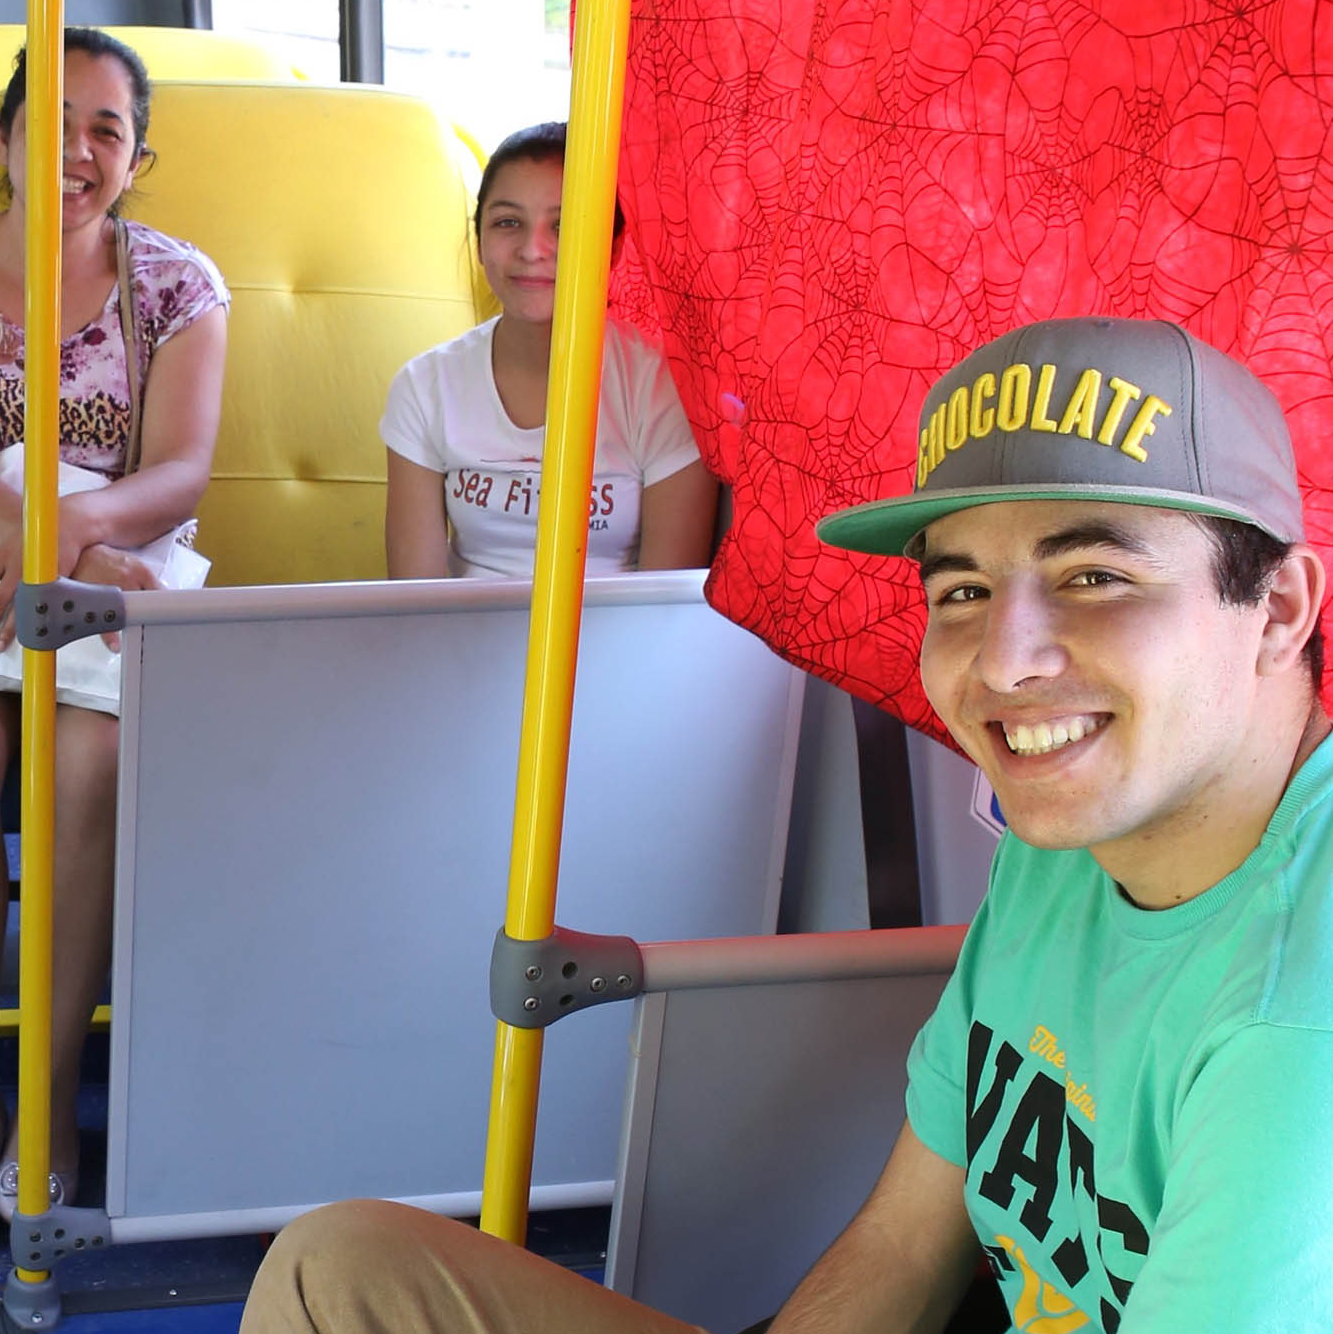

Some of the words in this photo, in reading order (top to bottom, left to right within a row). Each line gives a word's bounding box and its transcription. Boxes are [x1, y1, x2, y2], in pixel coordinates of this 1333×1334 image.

[917, 362, 1173, 489] CHOCOLATE
[452, 468, 494, 508] Sea
[1028, 1024, 1066, 1069] The
